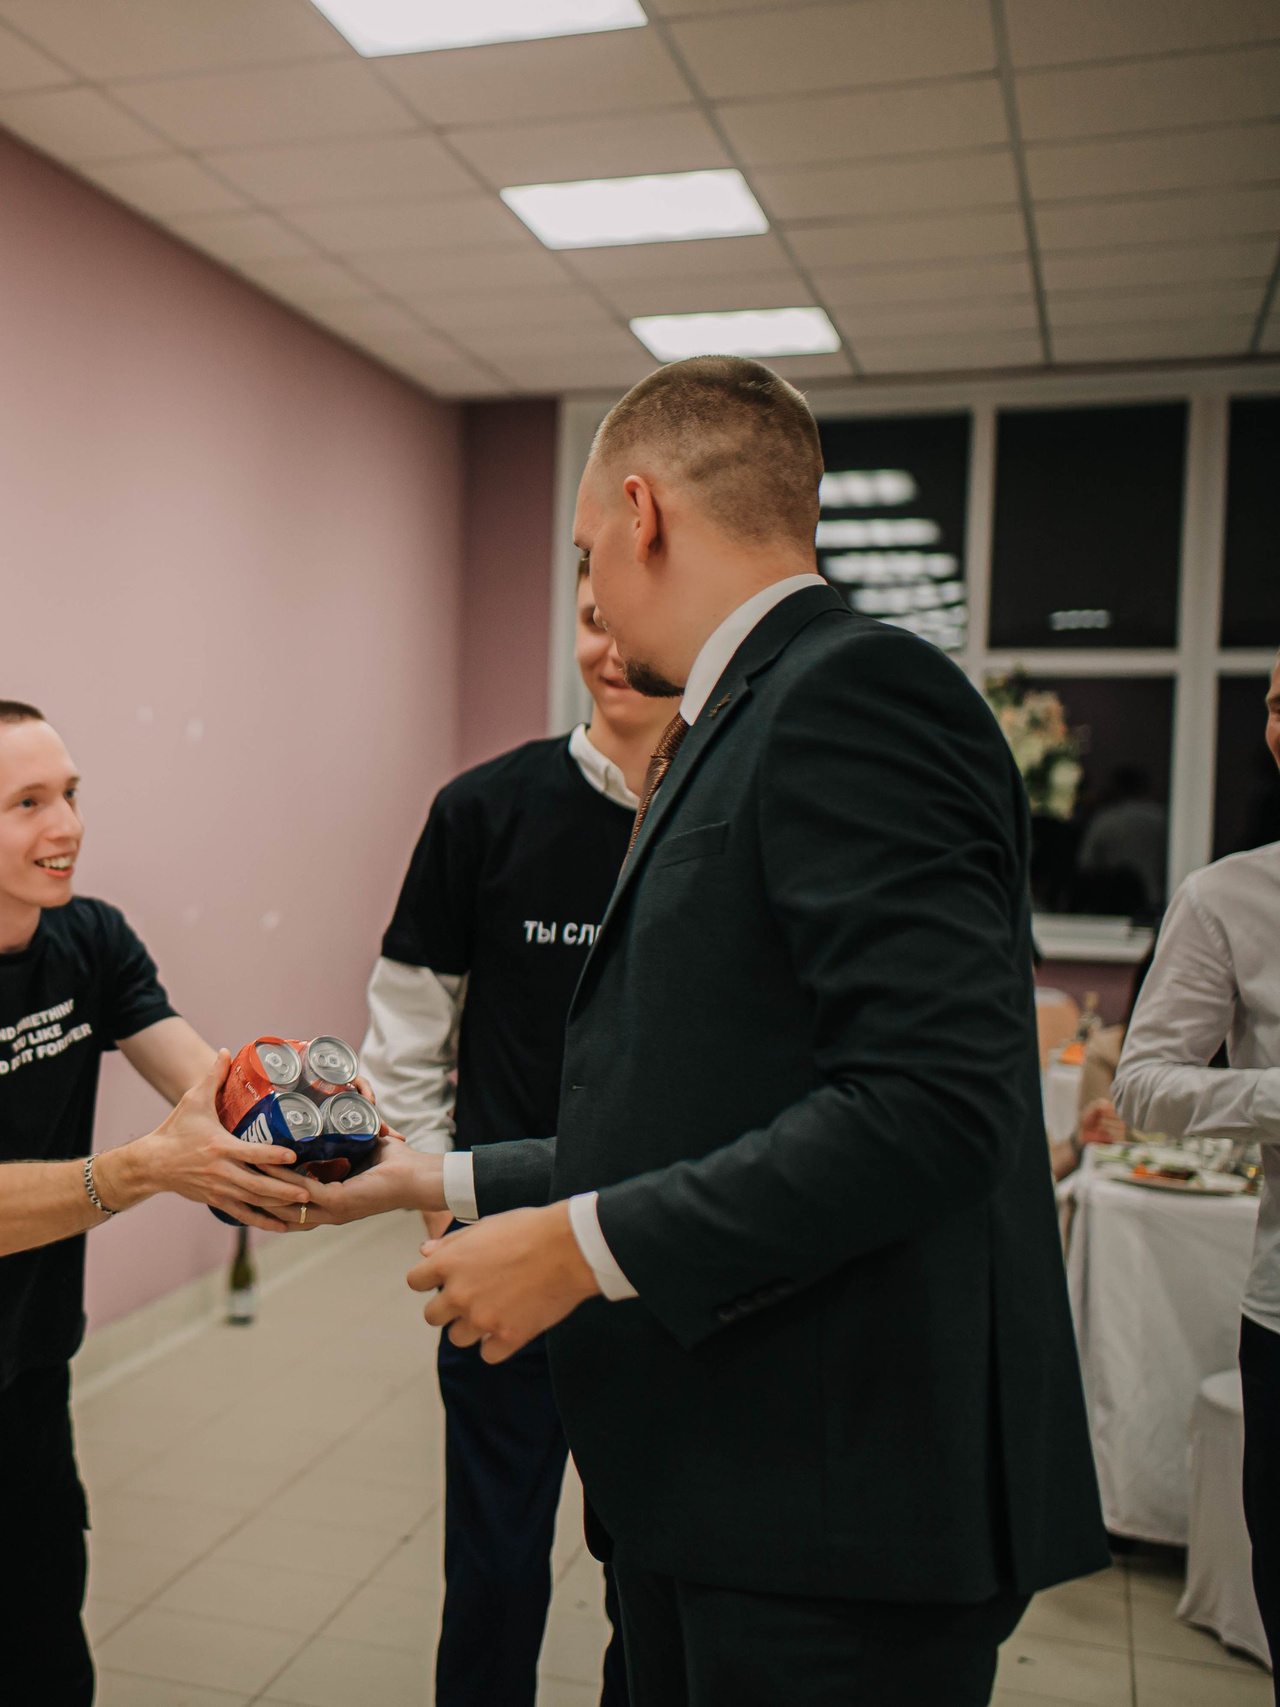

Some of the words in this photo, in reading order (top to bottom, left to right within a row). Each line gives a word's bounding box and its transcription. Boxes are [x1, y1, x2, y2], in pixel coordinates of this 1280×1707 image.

[523, 919, 557, 944] ТЫ
[27, 1023, 63, 1045] LIKE
[21, 1048, 34, 1064] IT
